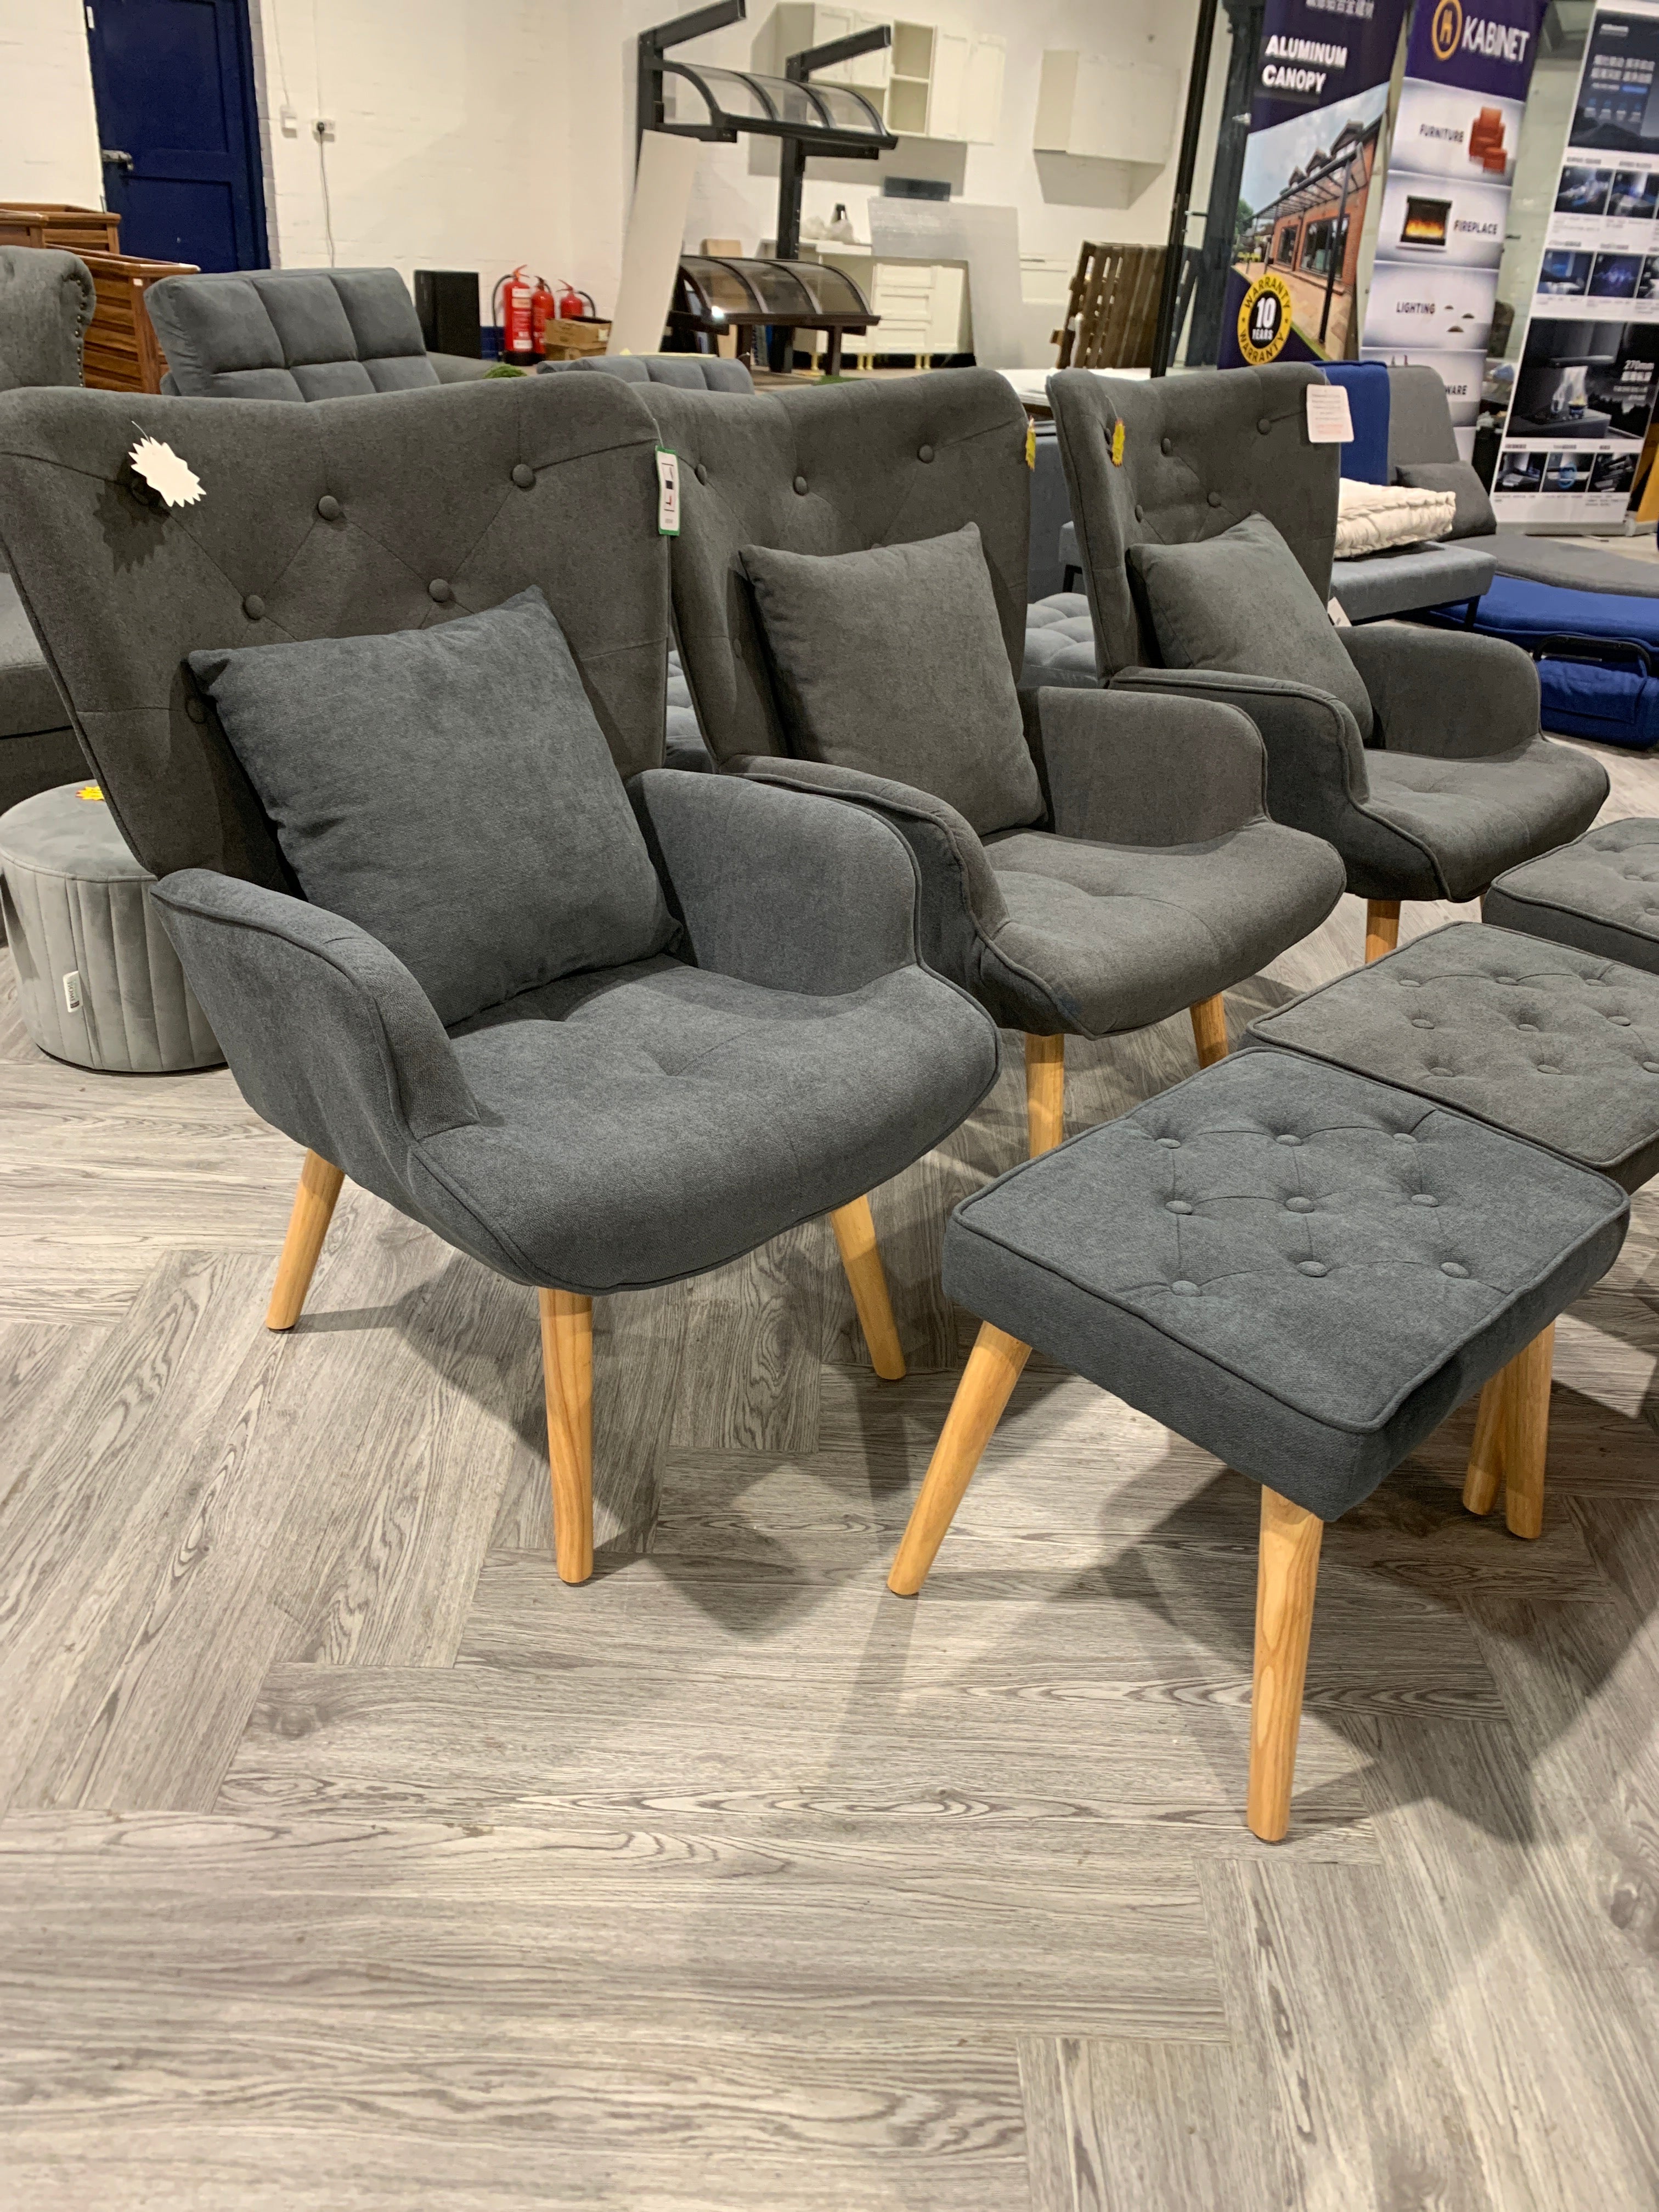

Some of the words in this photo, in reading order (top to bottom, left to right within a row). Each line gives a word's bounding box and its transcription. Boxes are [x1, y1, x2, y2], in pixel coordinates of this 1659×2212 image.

[1265, 35, 1347, 69] ALUMINUM
[1462, 15, 1530, 63] KABINET
[1262, 64, 1327, 93] CANOPY
[1419, 123, 1464, 143] FURNITURE
[1453, 219, 1498, 235] FIREPLACE
[1244, 276, 1290, 308] WARRANTY
[1256, 297, 1277, 328] 10
[1396, 301, 1435, 314] LIGHTING
[1239, 329, 1284, 363] WARRANTY
[1252, 329, 1274, 341] YEARS
[1445, 385, 1468, 396] WARE
